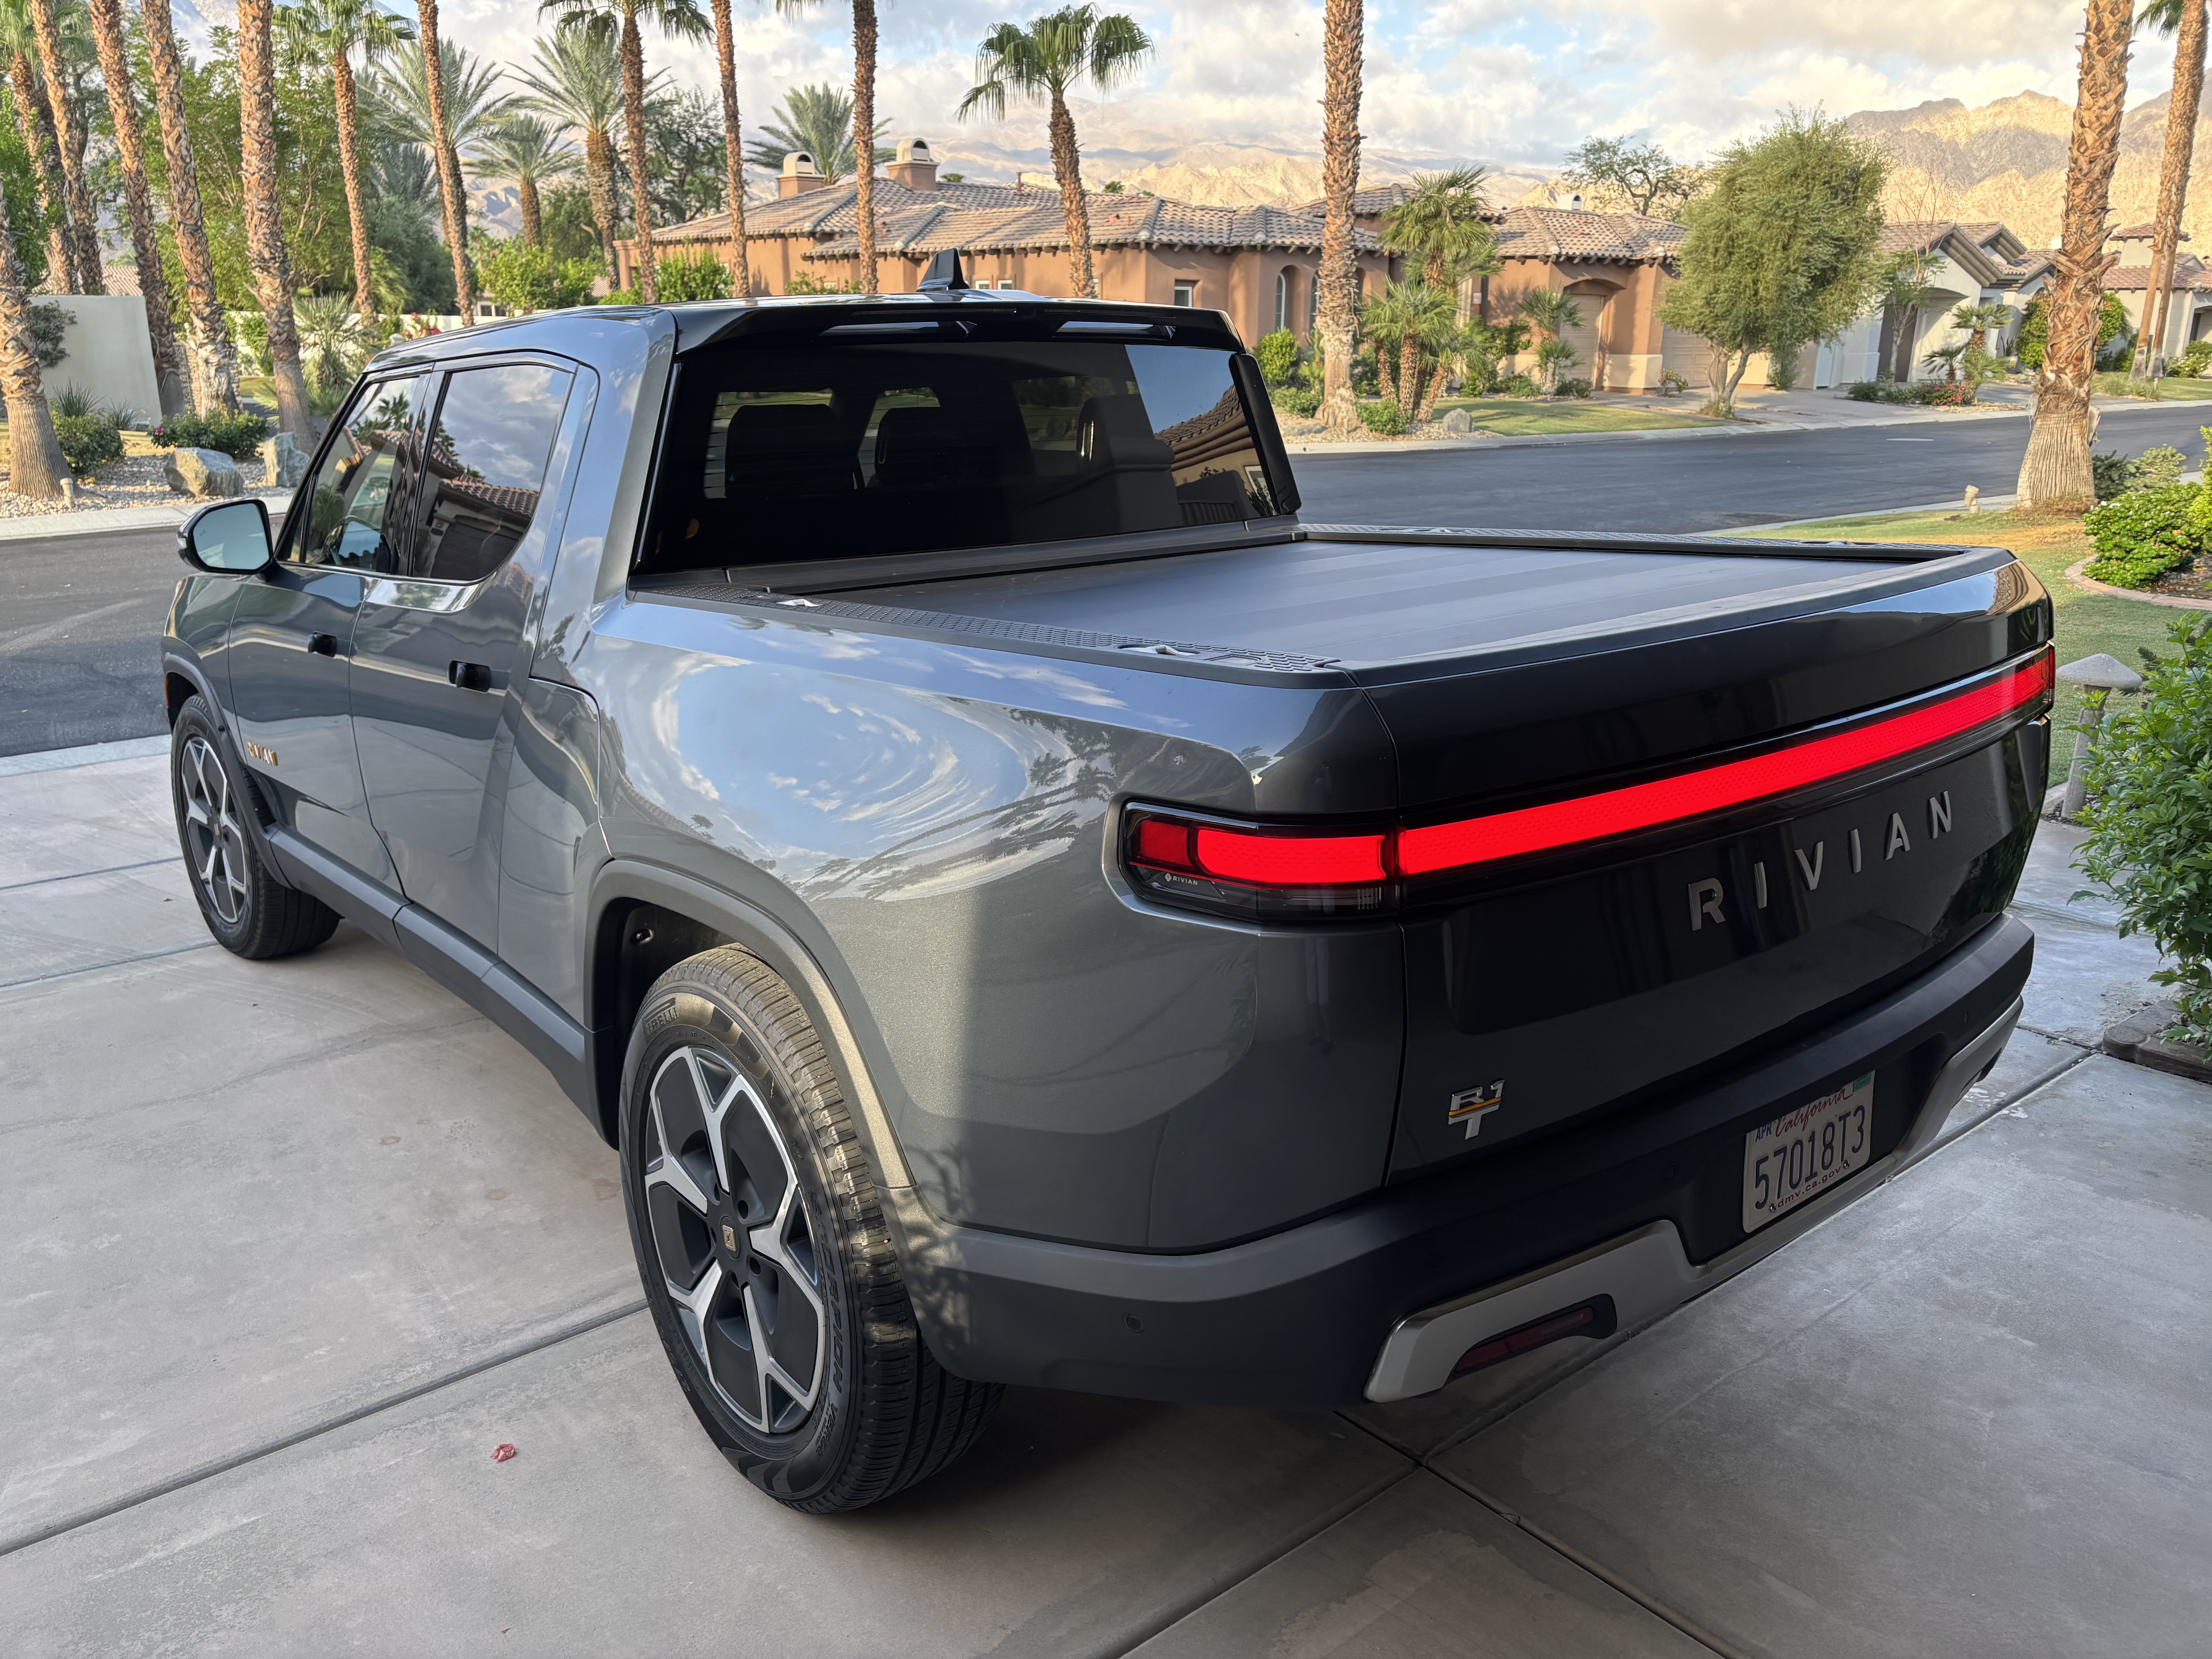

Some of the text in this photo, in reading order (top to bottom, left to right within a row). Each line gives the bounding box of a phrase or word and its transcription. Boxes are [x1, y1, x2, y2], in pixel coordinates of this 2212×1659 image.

[1173, 876, 1198, 886] RIVIAN
[1688, 791, 1951, 931] RIVIAN
[1755, 1121, 1772, 1142] APR
[1775, 1088, 1853, 1138] California
[1755, 1105, 1865, 1209] 57018T3
[1778, 1166, 1841, 1208] dmv.ca.gov
[808, 1188, 843, 1393] SCORPION
